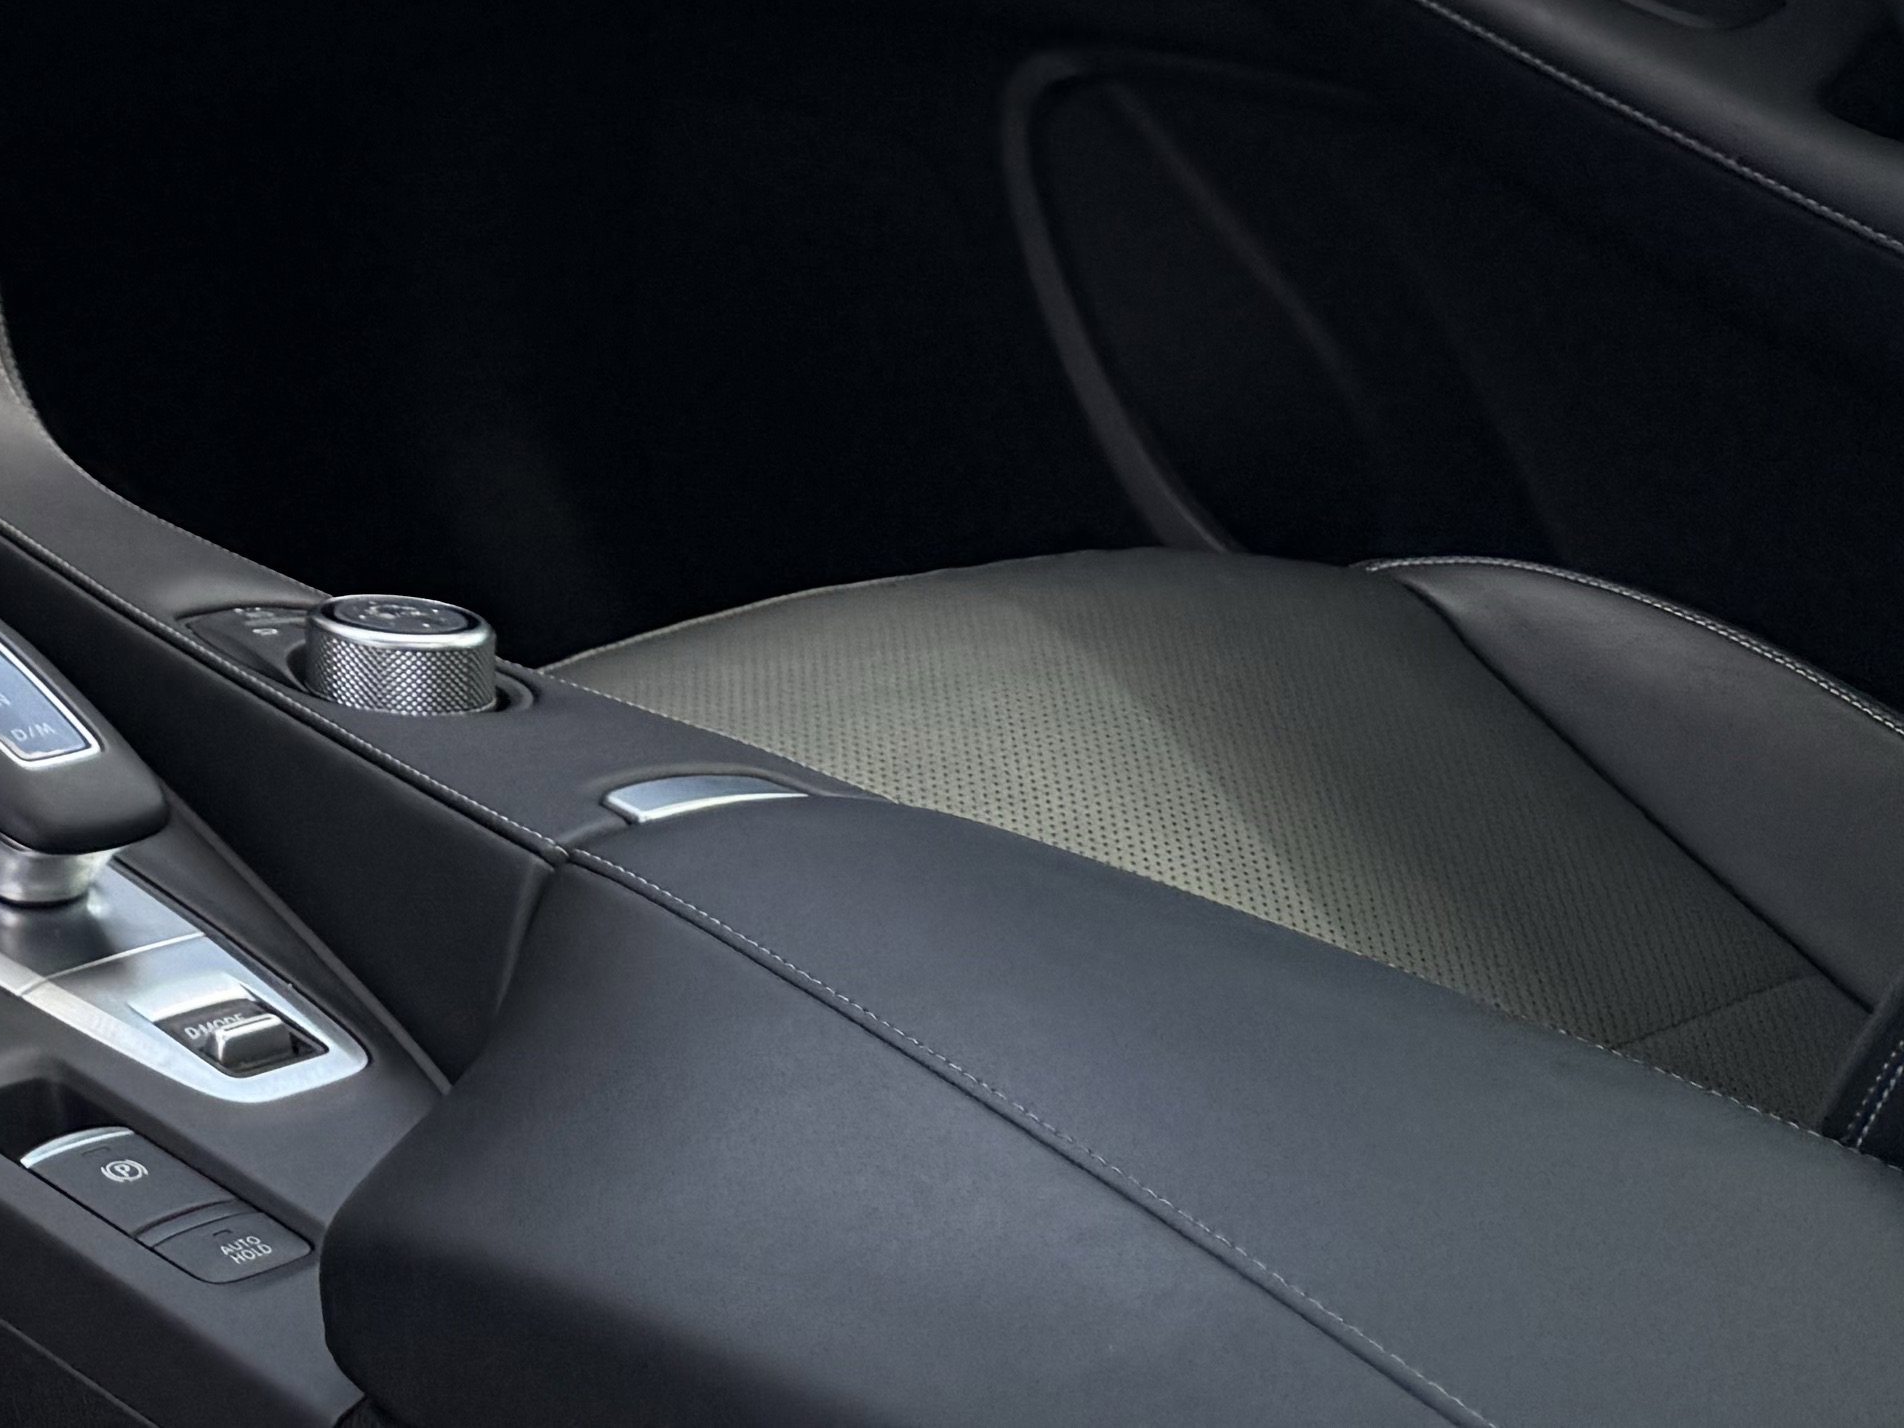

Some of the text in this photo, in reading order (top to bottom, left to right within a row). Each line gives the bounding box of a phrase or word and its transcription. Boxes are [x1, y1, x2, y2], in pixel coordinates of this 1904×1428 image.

[11, 722, 56, 742] D/M
[220, 1235, 261, 1256] AUTO
[229, 1244, 273, 1265] HOLD
